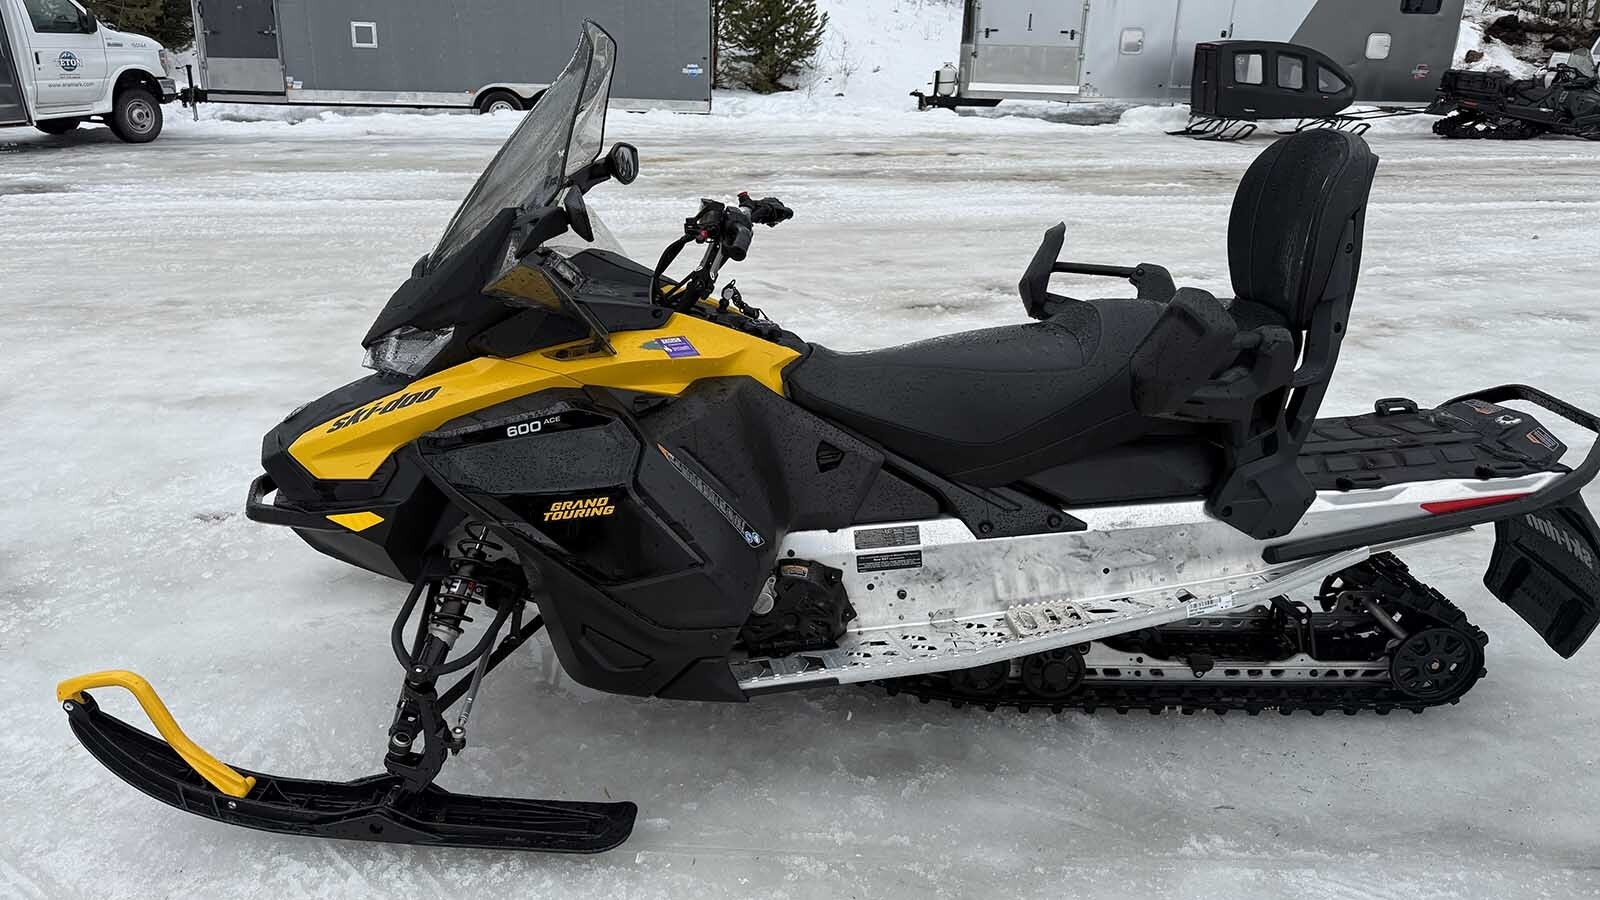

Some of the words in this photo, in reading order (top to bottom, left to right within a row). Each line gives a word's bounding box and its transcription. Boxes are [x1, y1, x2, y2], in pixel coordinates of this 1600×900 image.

[507, 421, 542, 437] 600
[543, 416, 561, 424] ACE
[550, 497, 609, 511] GRAND
[543, 505, 615, 521] TOURING
